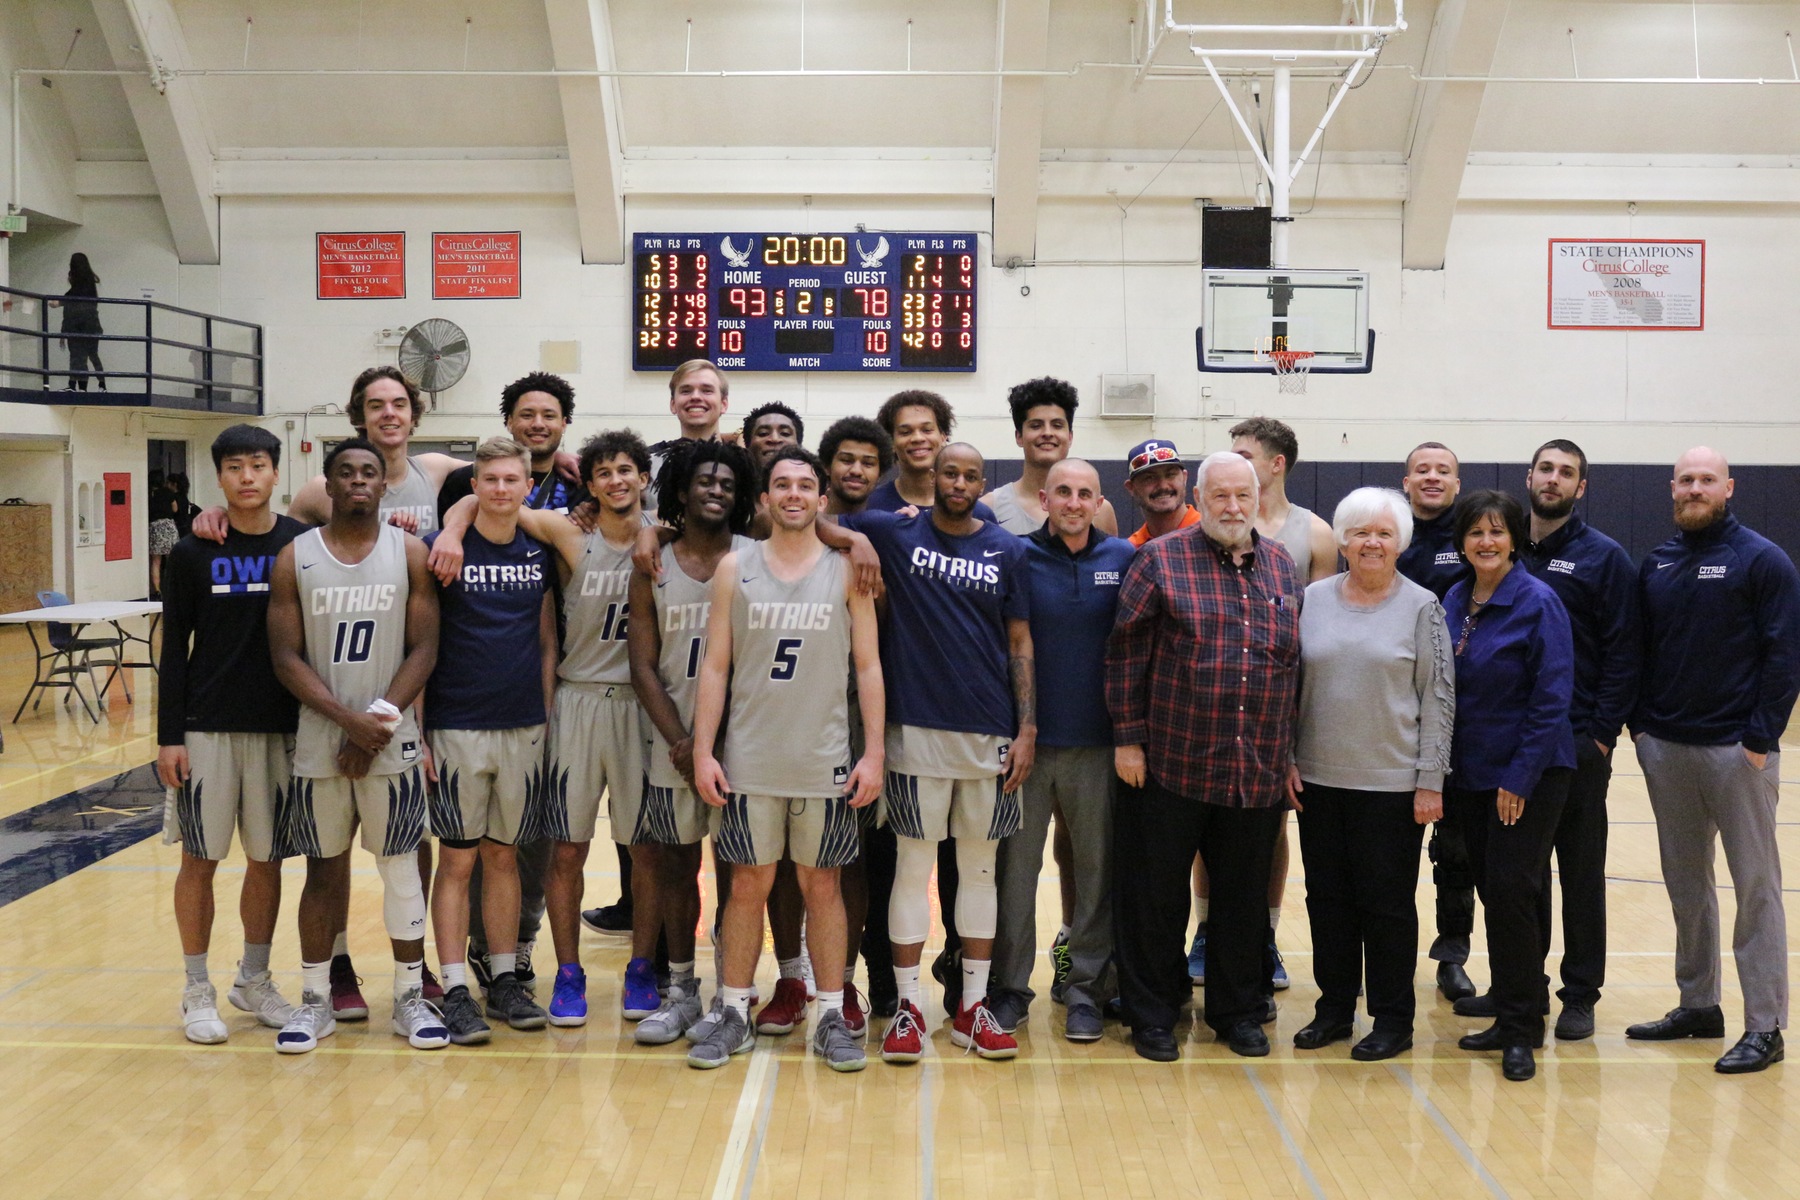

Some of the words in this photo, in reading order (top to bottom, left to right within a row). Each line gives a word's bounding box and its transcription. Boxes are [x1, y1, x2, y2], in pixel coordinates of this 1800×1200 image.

[644, 239, 662, 248] PLYR
[668, 239, 680, 248] FLS
[687, 239, 700, 248] PTS
[764, 236, 845, 264] 20:00
[908, 240, 926, 248] PLYR
[932, 240, 944, 248] FLS
[952, 240, 966, 248] PTS
[1560, 246, 1604, 258] STATE
[1607, 246, 1694, 258] CHAMPIONS
[350, 264, 372, 272] 2012
[467, 264, 486, 272] 2011
[650, 254, 660, 270] 5
[670, 254, 678, 270] 3
[696, 254, 706, 270] 0
[914, 255, 924, 271] 2
[938, 256, 942, 270] 1
[961, 256, 970, 270] 0
[1582, 260, 1622, 272] Citrus
[1623, 259, 1669, 276] College
[645, 273, 660, 288] 10
[670, 273, 678, 288] 3
[696, 273, 706, 288] 2
[724, 271, 762, 284] HOME
[788, 278, 820, 288] PERIOD
[844, 271, 887, 284] GUEST
[910, 275, 924, 288] 11
[932, 275, 942, 288] 4
[962, 276, 970, 288] 4
[1613, 278, 1642, 288] 2008
[645, 293, 660, 308] 12
[674, 294, 678, 307] 1
[685, 293, 706, 308] 48
[730, 288, 765, 316] 93
[798, 292, 811, 313] 2
[854, 288, 888, 316] 78
[903, 294, 924, 310] 23
[932, 294, 942, 309] 2
[956, 295, 970, 308] 11
[645, 312, 660, 327] 15
[668, 312, 678, 326] 2
[685, 312, 706, 326] 23
[718, 320, 746, 329] FOULS
[774, 320, 807, 330] PLAYER
[812, 320, 834, 330] FOUL
[863, 320, 891, 330] FOULS
[904, 312, 924, 328] 33
[932, 312, 942, 328] 0
[962, 312, 970, 328] 3
[640, 332, 660, 347] 32
[668, 332, 678, 346] 2
[696, 332, 706, 346] 2
[722, 331, 742, 352] 10
[867, 332, 886, 352] 10
[903, 332, 924, 348] 42
[932, 332, 942, 348] 0
[961, 332, 970, 348] 0
[717, 358, 746, 366] SCORE
[790, 358, 820, 366] MATCH
[862, 358, 891, 367] SCORE
[1145, 442, 1158, 459] C
[912, 546, 1000, 584] CITRUS
[1550, 559, 1576, 570] CITRUS
[1700, 566, 1726, 574] CITRUS
[464, 564, 543, 584] CITRUS
[910, 565, 997, 594] BASKETBALL
[1094, 572, 1119, 580] CITRUS
[312, 584, 396, 616] CITRUS
[748, 602, 833, 630] CITRUS
[332, 619, 376, 664] 10
[769, 637, 804, 682] 5
[605, 687, 614, 698] C
